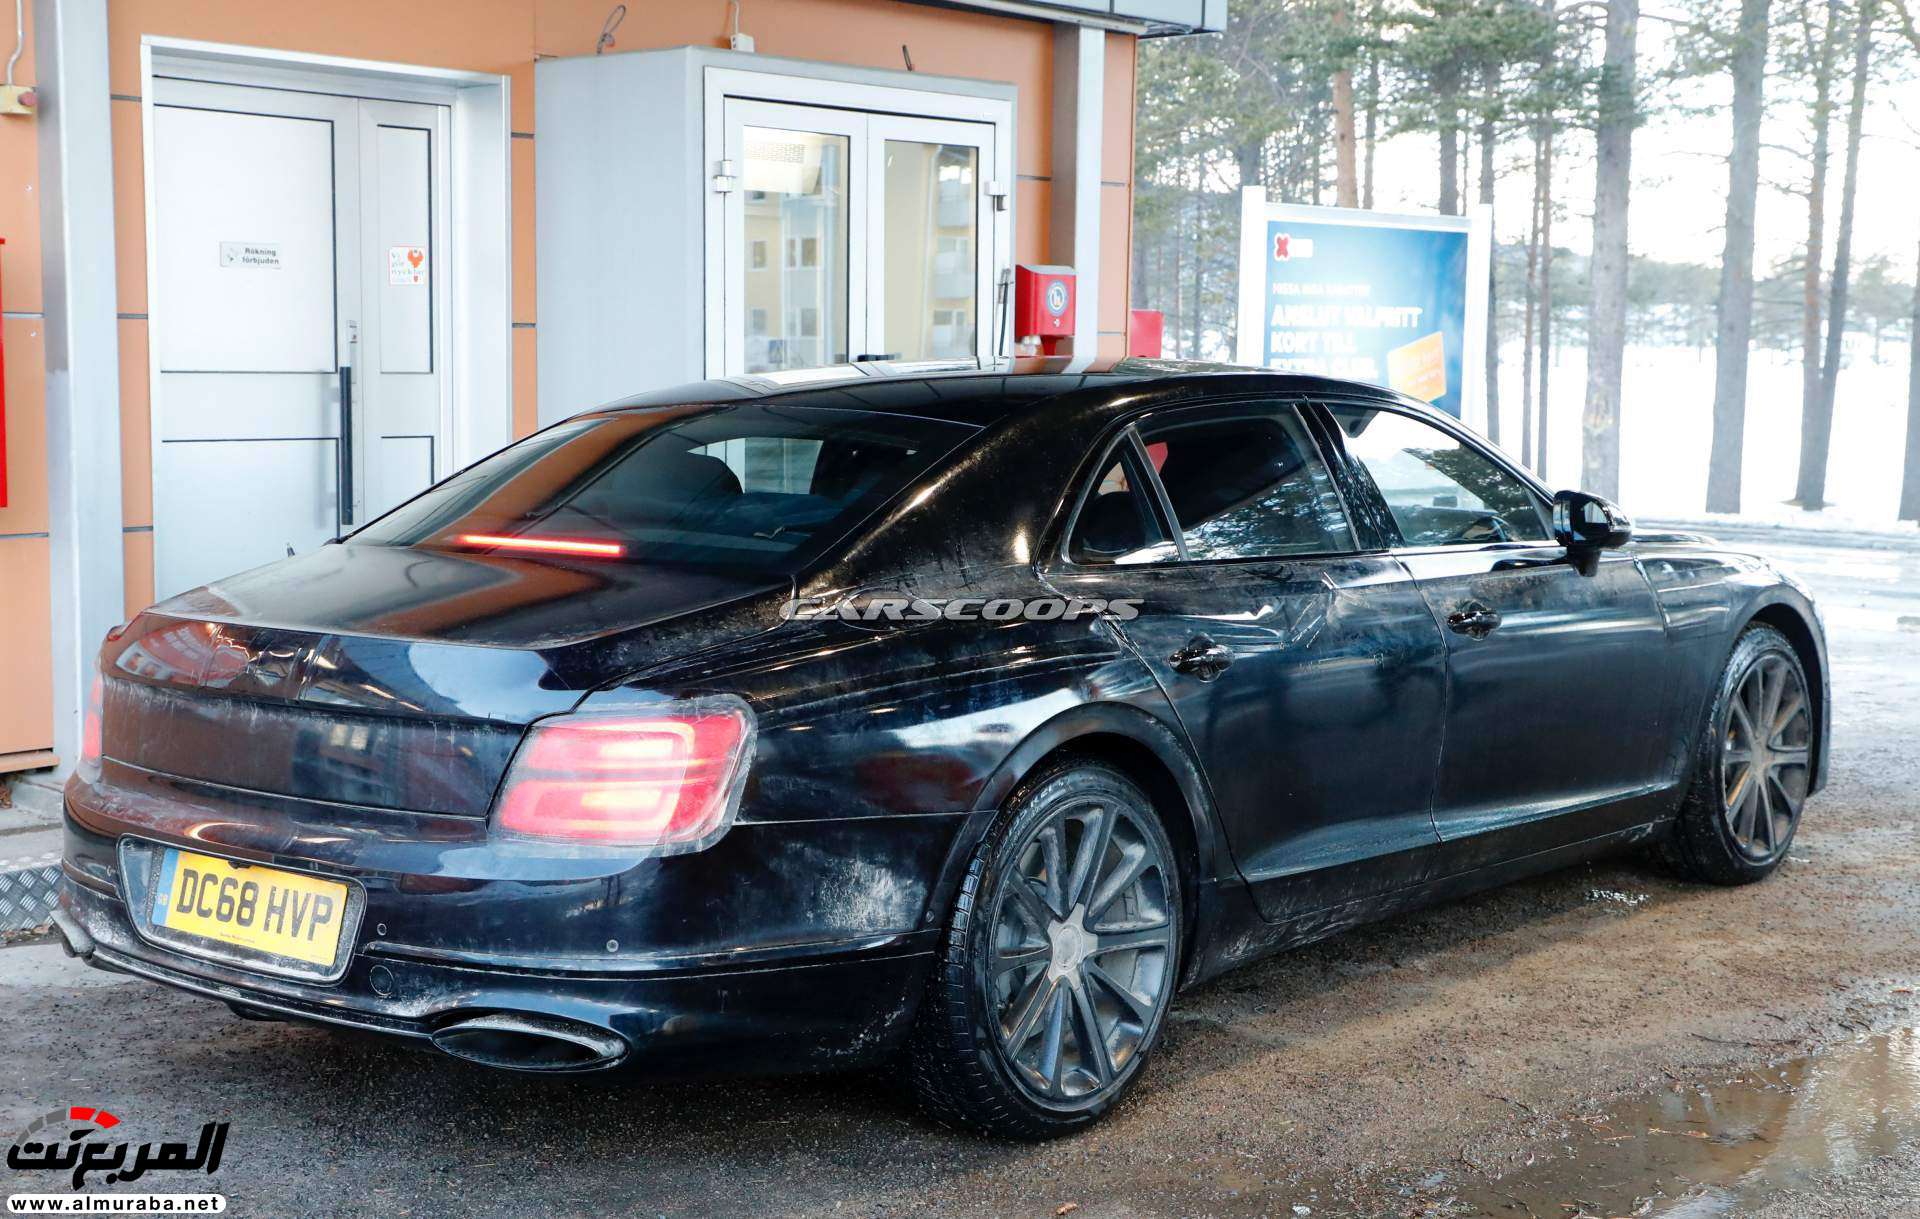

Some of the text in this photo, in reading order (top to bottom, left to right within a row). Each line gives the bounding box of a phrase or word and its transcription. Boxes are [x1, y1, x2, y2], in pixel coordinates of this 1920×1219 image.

[244, 247, 277, 257] Rökning
[242, 256, 280, 265] förbjuden
[175, 867, 334, 942] DC68 HVP
